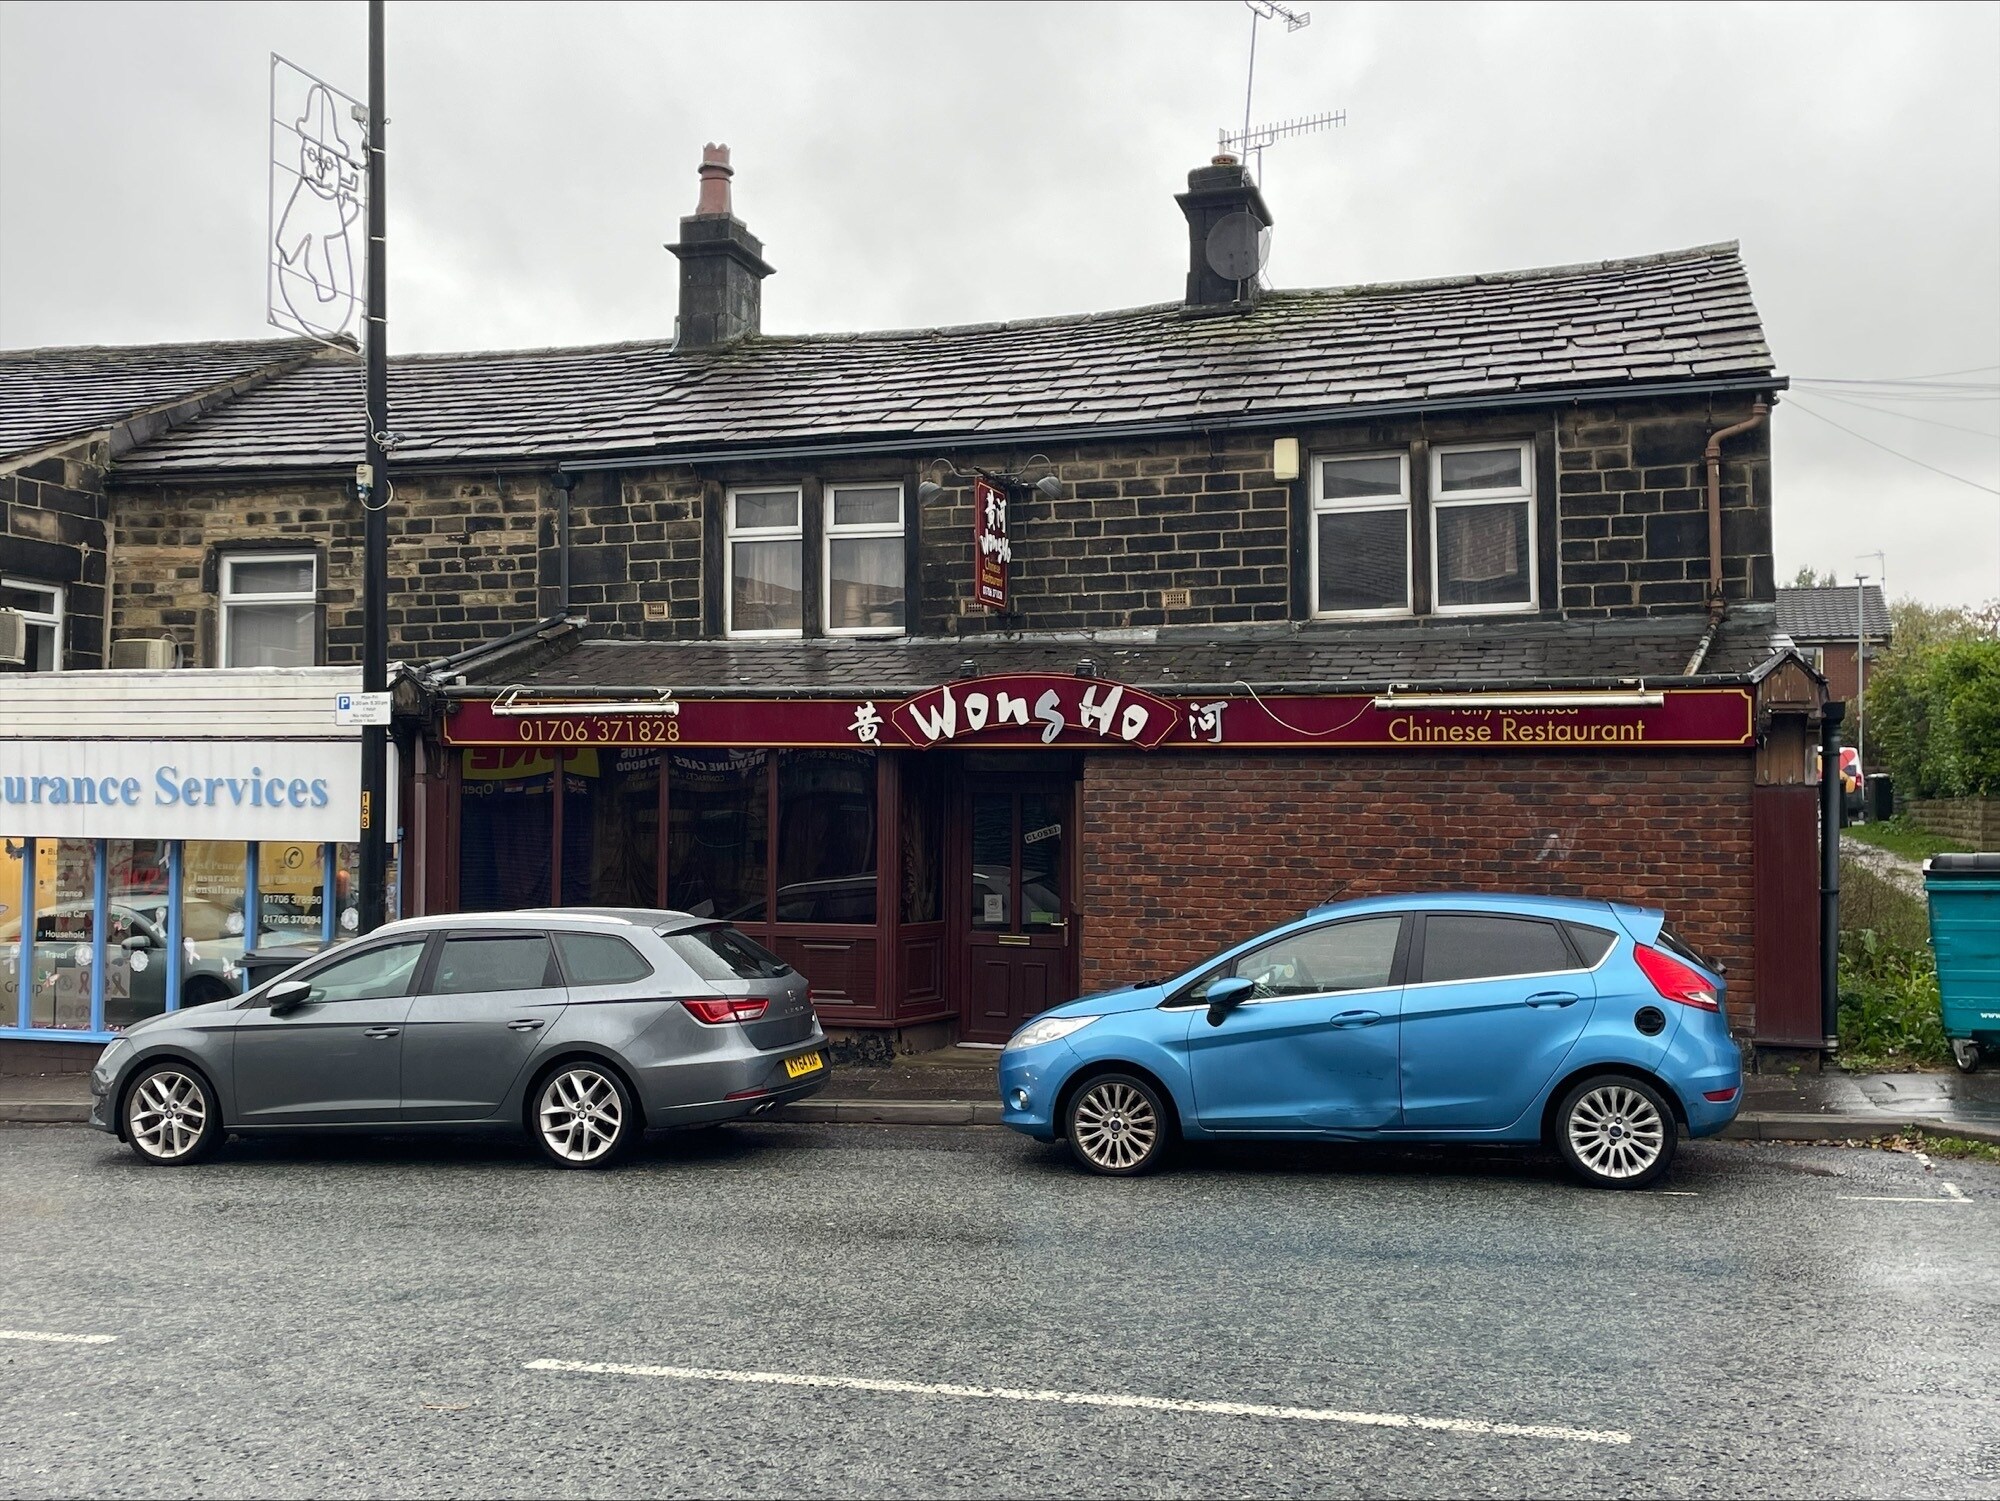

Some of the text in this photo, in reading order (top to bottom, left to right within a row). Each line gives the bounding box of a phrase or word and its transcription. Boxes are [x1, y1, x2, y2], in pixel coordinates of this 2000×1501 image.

[909, 685, 1149, 744] Wong Ho
[1188, 701, 1228, 742] 河
[519, 720, 680, 742] 01706 371828
[1388, 716, 1645, 742] Chinese Restaurant
[0, 766, 329, 807] urance Services
[1026, 826, 1060, 841] CLOSED
[264, 894, 289, 903] 01706
[74, 910, 87, 918] Car
[263, 914, 322, 925] 01706 370094
[45, 930, 86, 939] Household
[45, 951, 68, 959] Travel
